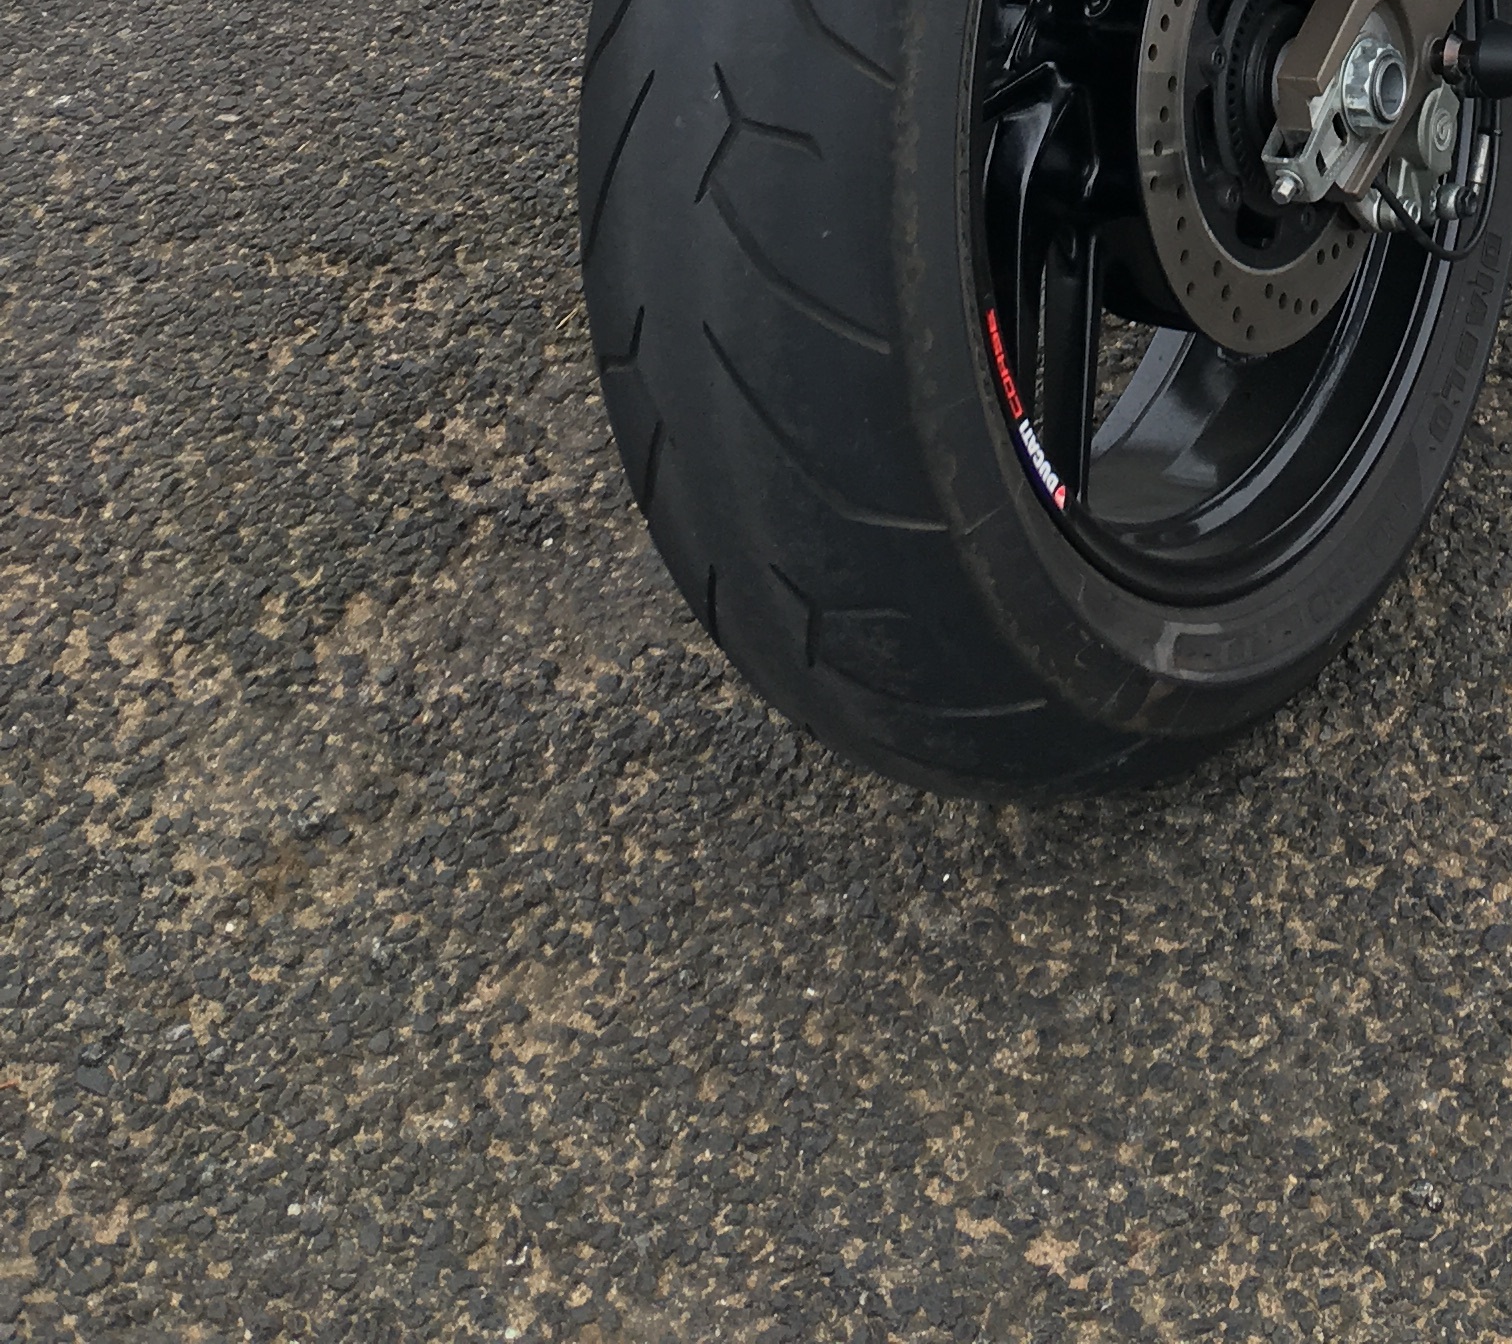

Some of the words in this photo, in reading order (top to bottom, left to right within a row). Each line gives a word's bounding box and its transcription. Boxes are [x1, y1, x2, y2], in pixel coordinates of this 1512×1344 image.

[985, 307, 1025, 420] CORSE
[1428, 230, 1503, 444] DIABLO
[1018, 417, 1061, 495] DUCATI
